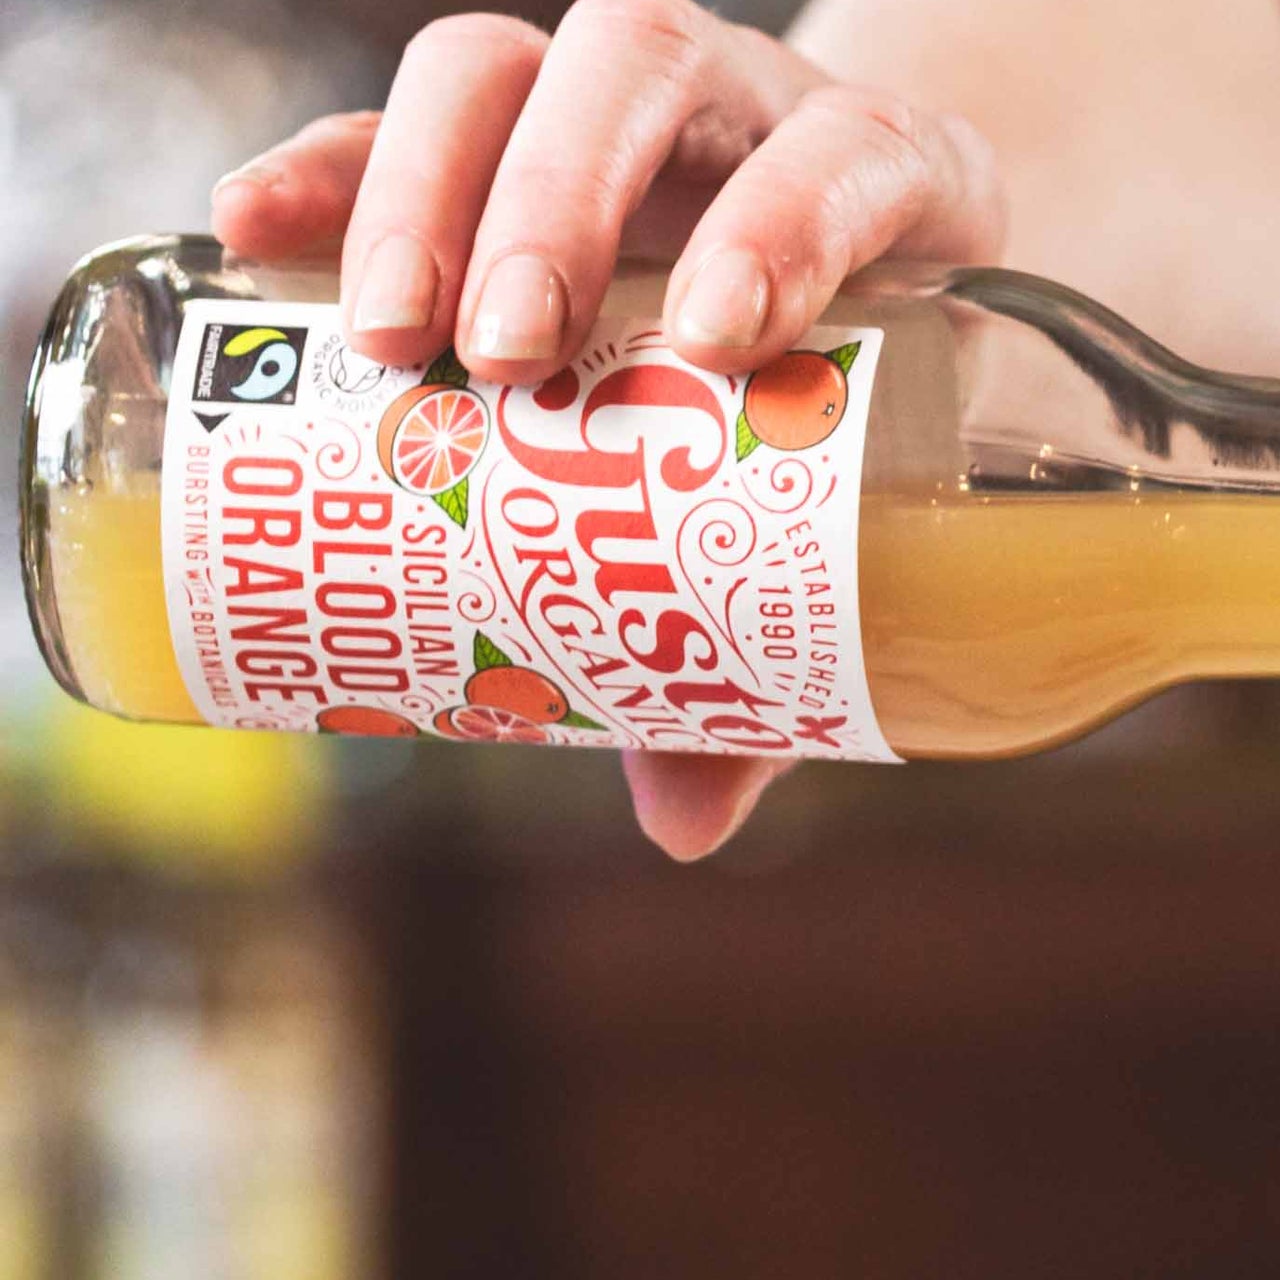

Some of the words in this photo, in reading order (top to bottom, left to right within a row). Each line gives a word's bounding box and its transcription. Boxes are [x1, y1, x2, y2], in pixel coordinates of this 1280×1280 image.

[197, 325, 223, 398] FAIRTRADE
[185, 445, 210, 561] BURSTING
[222, 456, 329, 706] ORANGE
[497, 363, 794, 750] Gusto
[191, 611, 239, 708] BOTANICALS
[313, 490, 412, 694] BLOOD
[402, 524, 461, 677] SICILIAN
[501, 487, 707, 746] ORGANIC
[758, 584, 798, 662] 1990
[785, 520, 840, 709] ESTABLISHED
